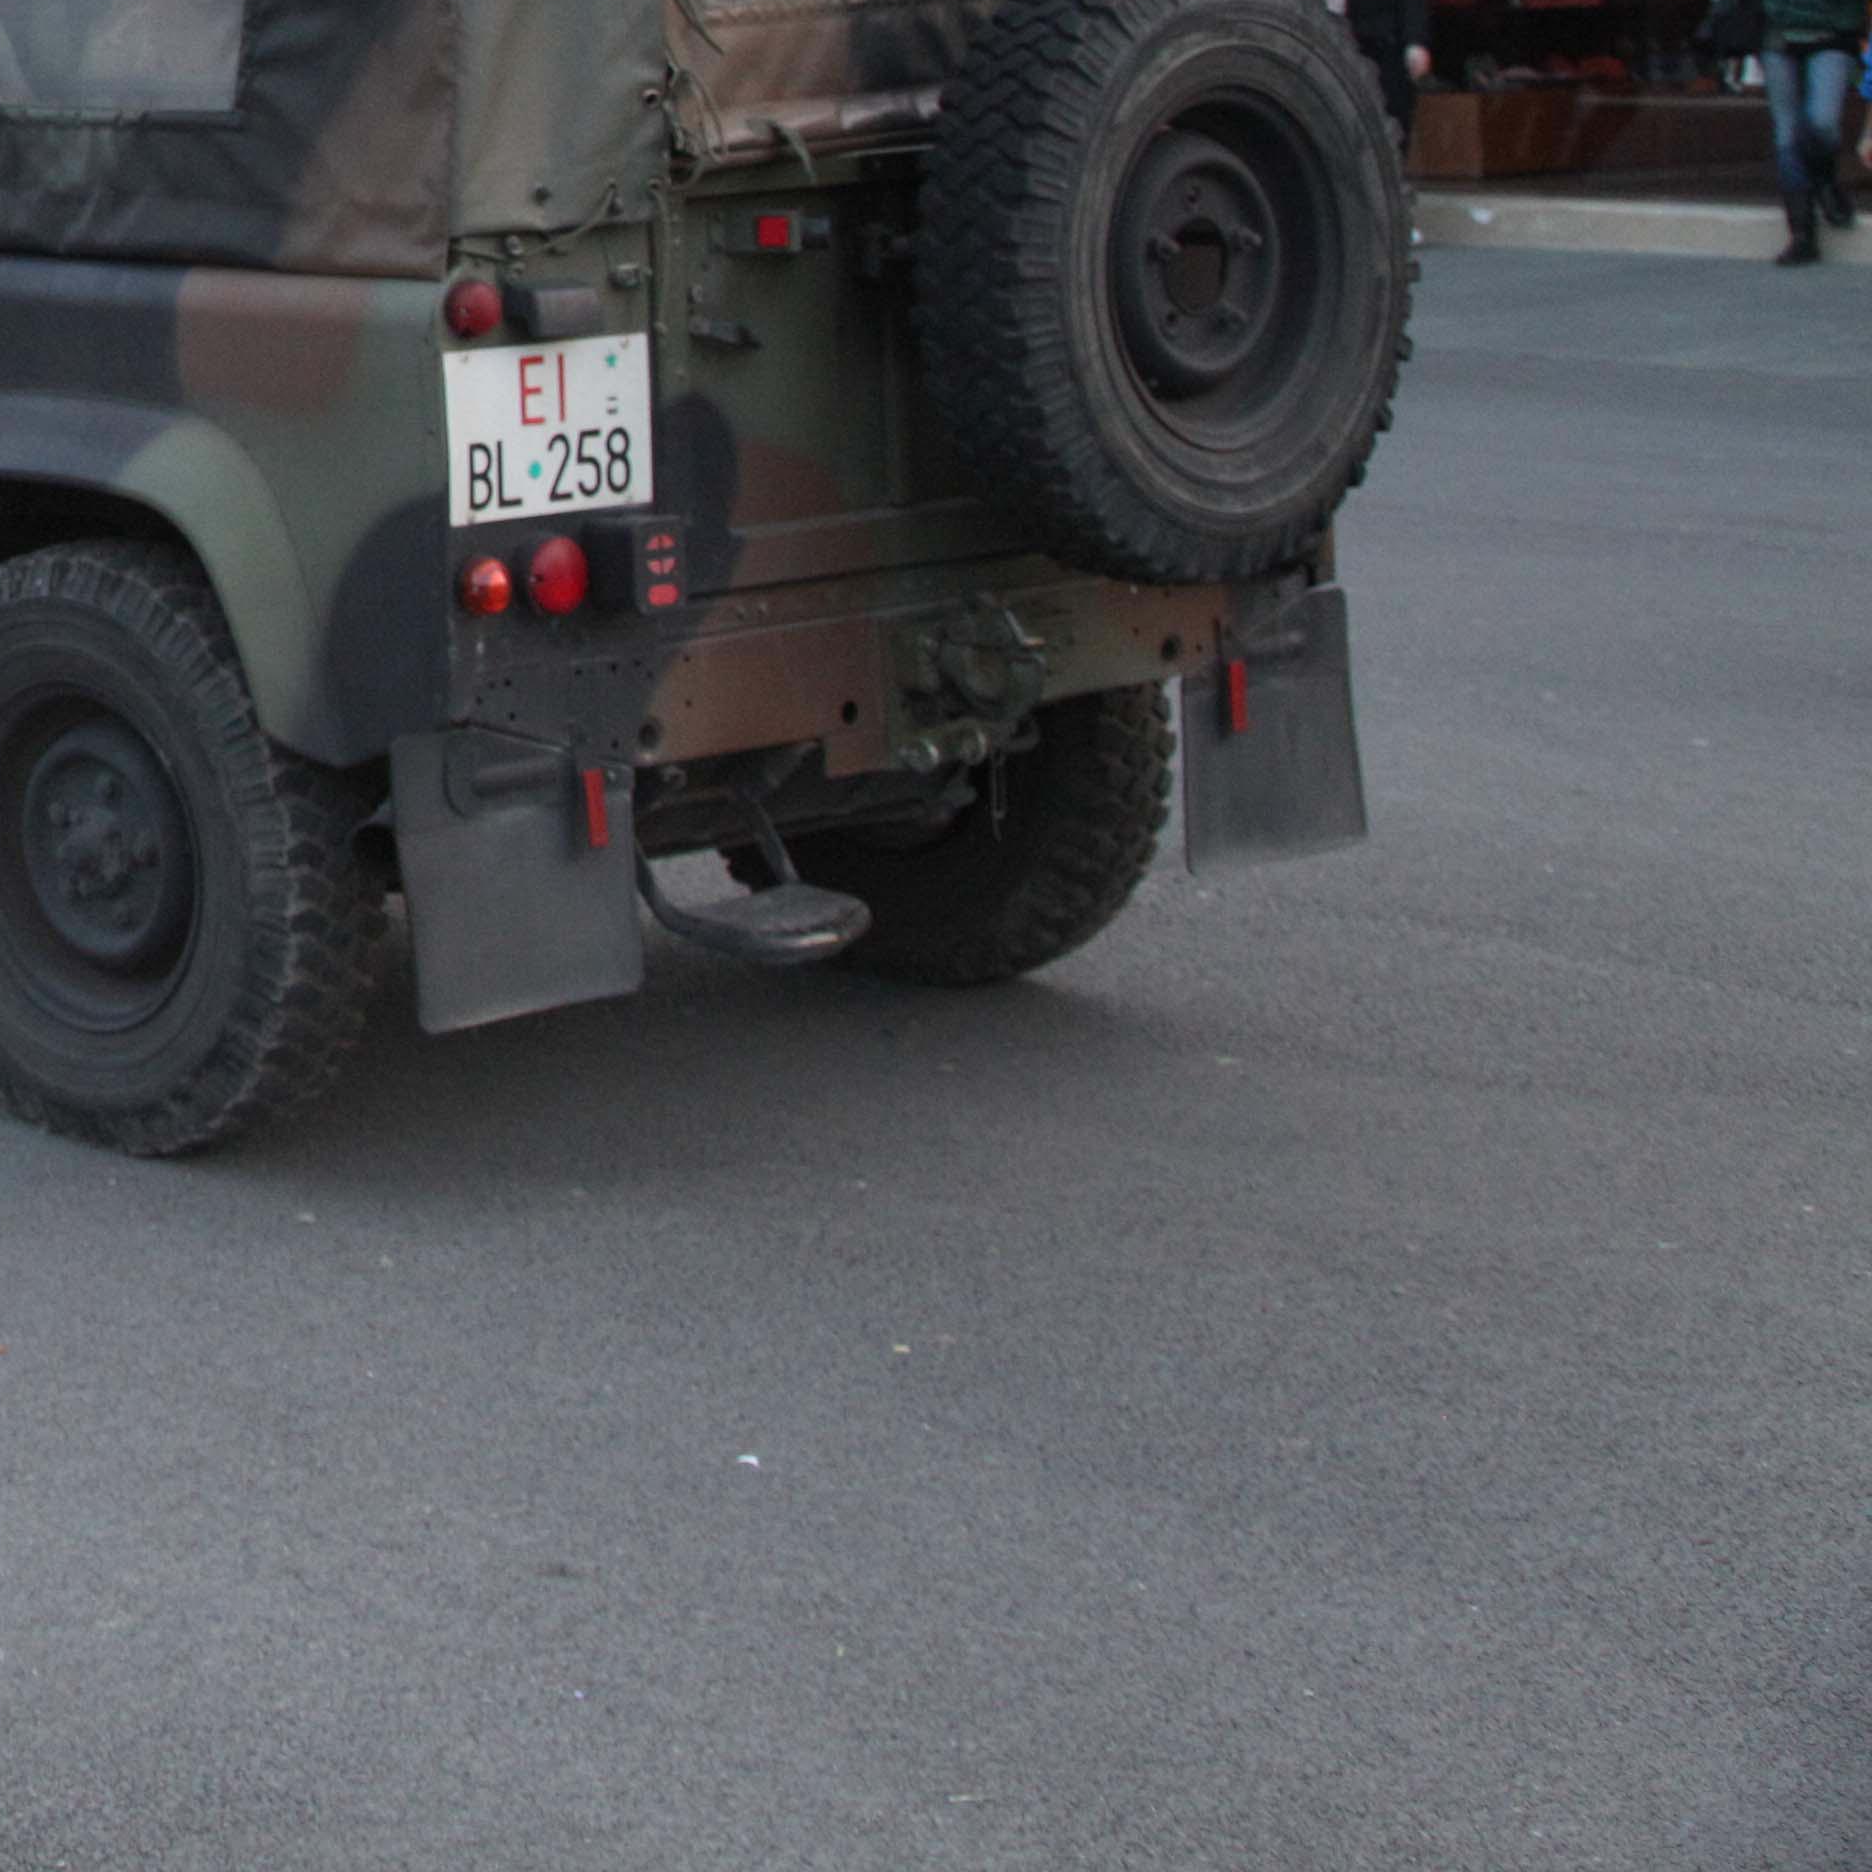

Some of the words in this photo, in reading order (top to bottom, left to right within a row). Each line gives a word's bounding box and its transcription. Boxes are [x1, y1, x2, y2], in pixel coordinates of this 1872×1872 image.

[518, 351, 566, 426] EI
[468, 439, 524, 511] BL
[546, 426, 633, 504] 258
